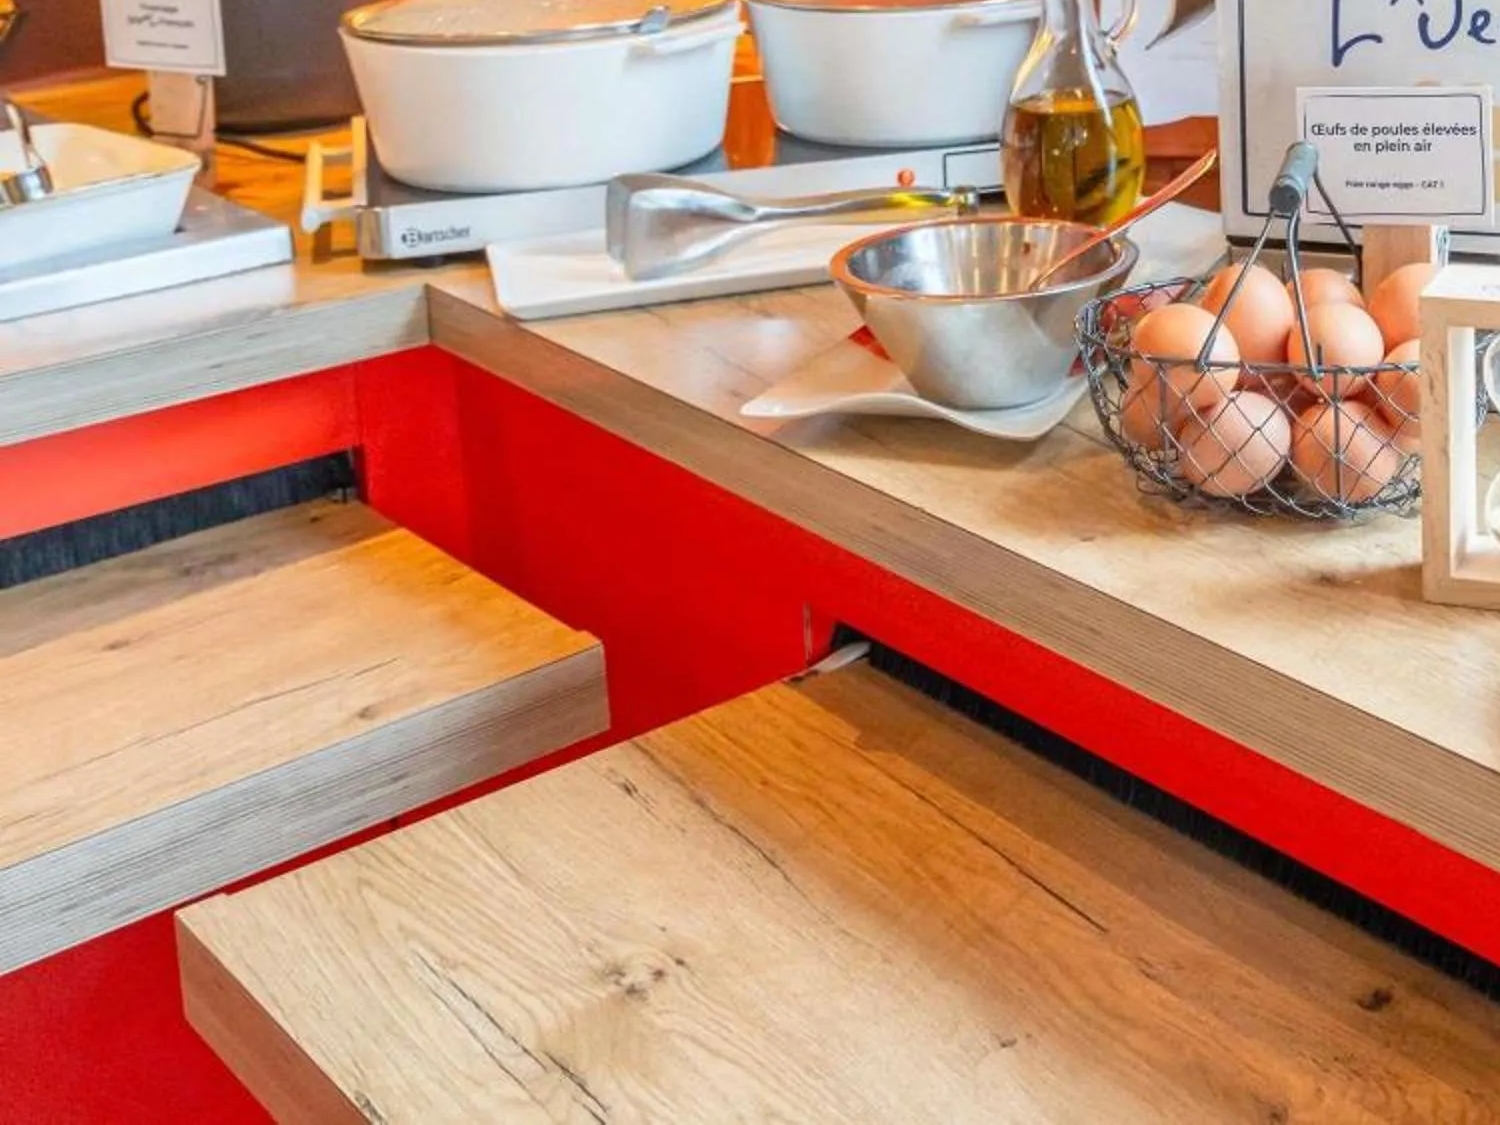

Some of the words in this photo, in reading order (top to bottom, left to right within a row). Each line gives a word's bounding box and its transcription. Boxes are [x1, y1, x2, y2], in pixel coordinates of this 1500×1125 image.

[1350, 123, 1369, 136] de
[1372, 123, 1419, 138] poules
[1422, 122, 1478, 136] élevées
[1353, 142, 1371, 152] en
[1375, 140, 1410, 155] plein
[1413, 140, 1432, 152] air
